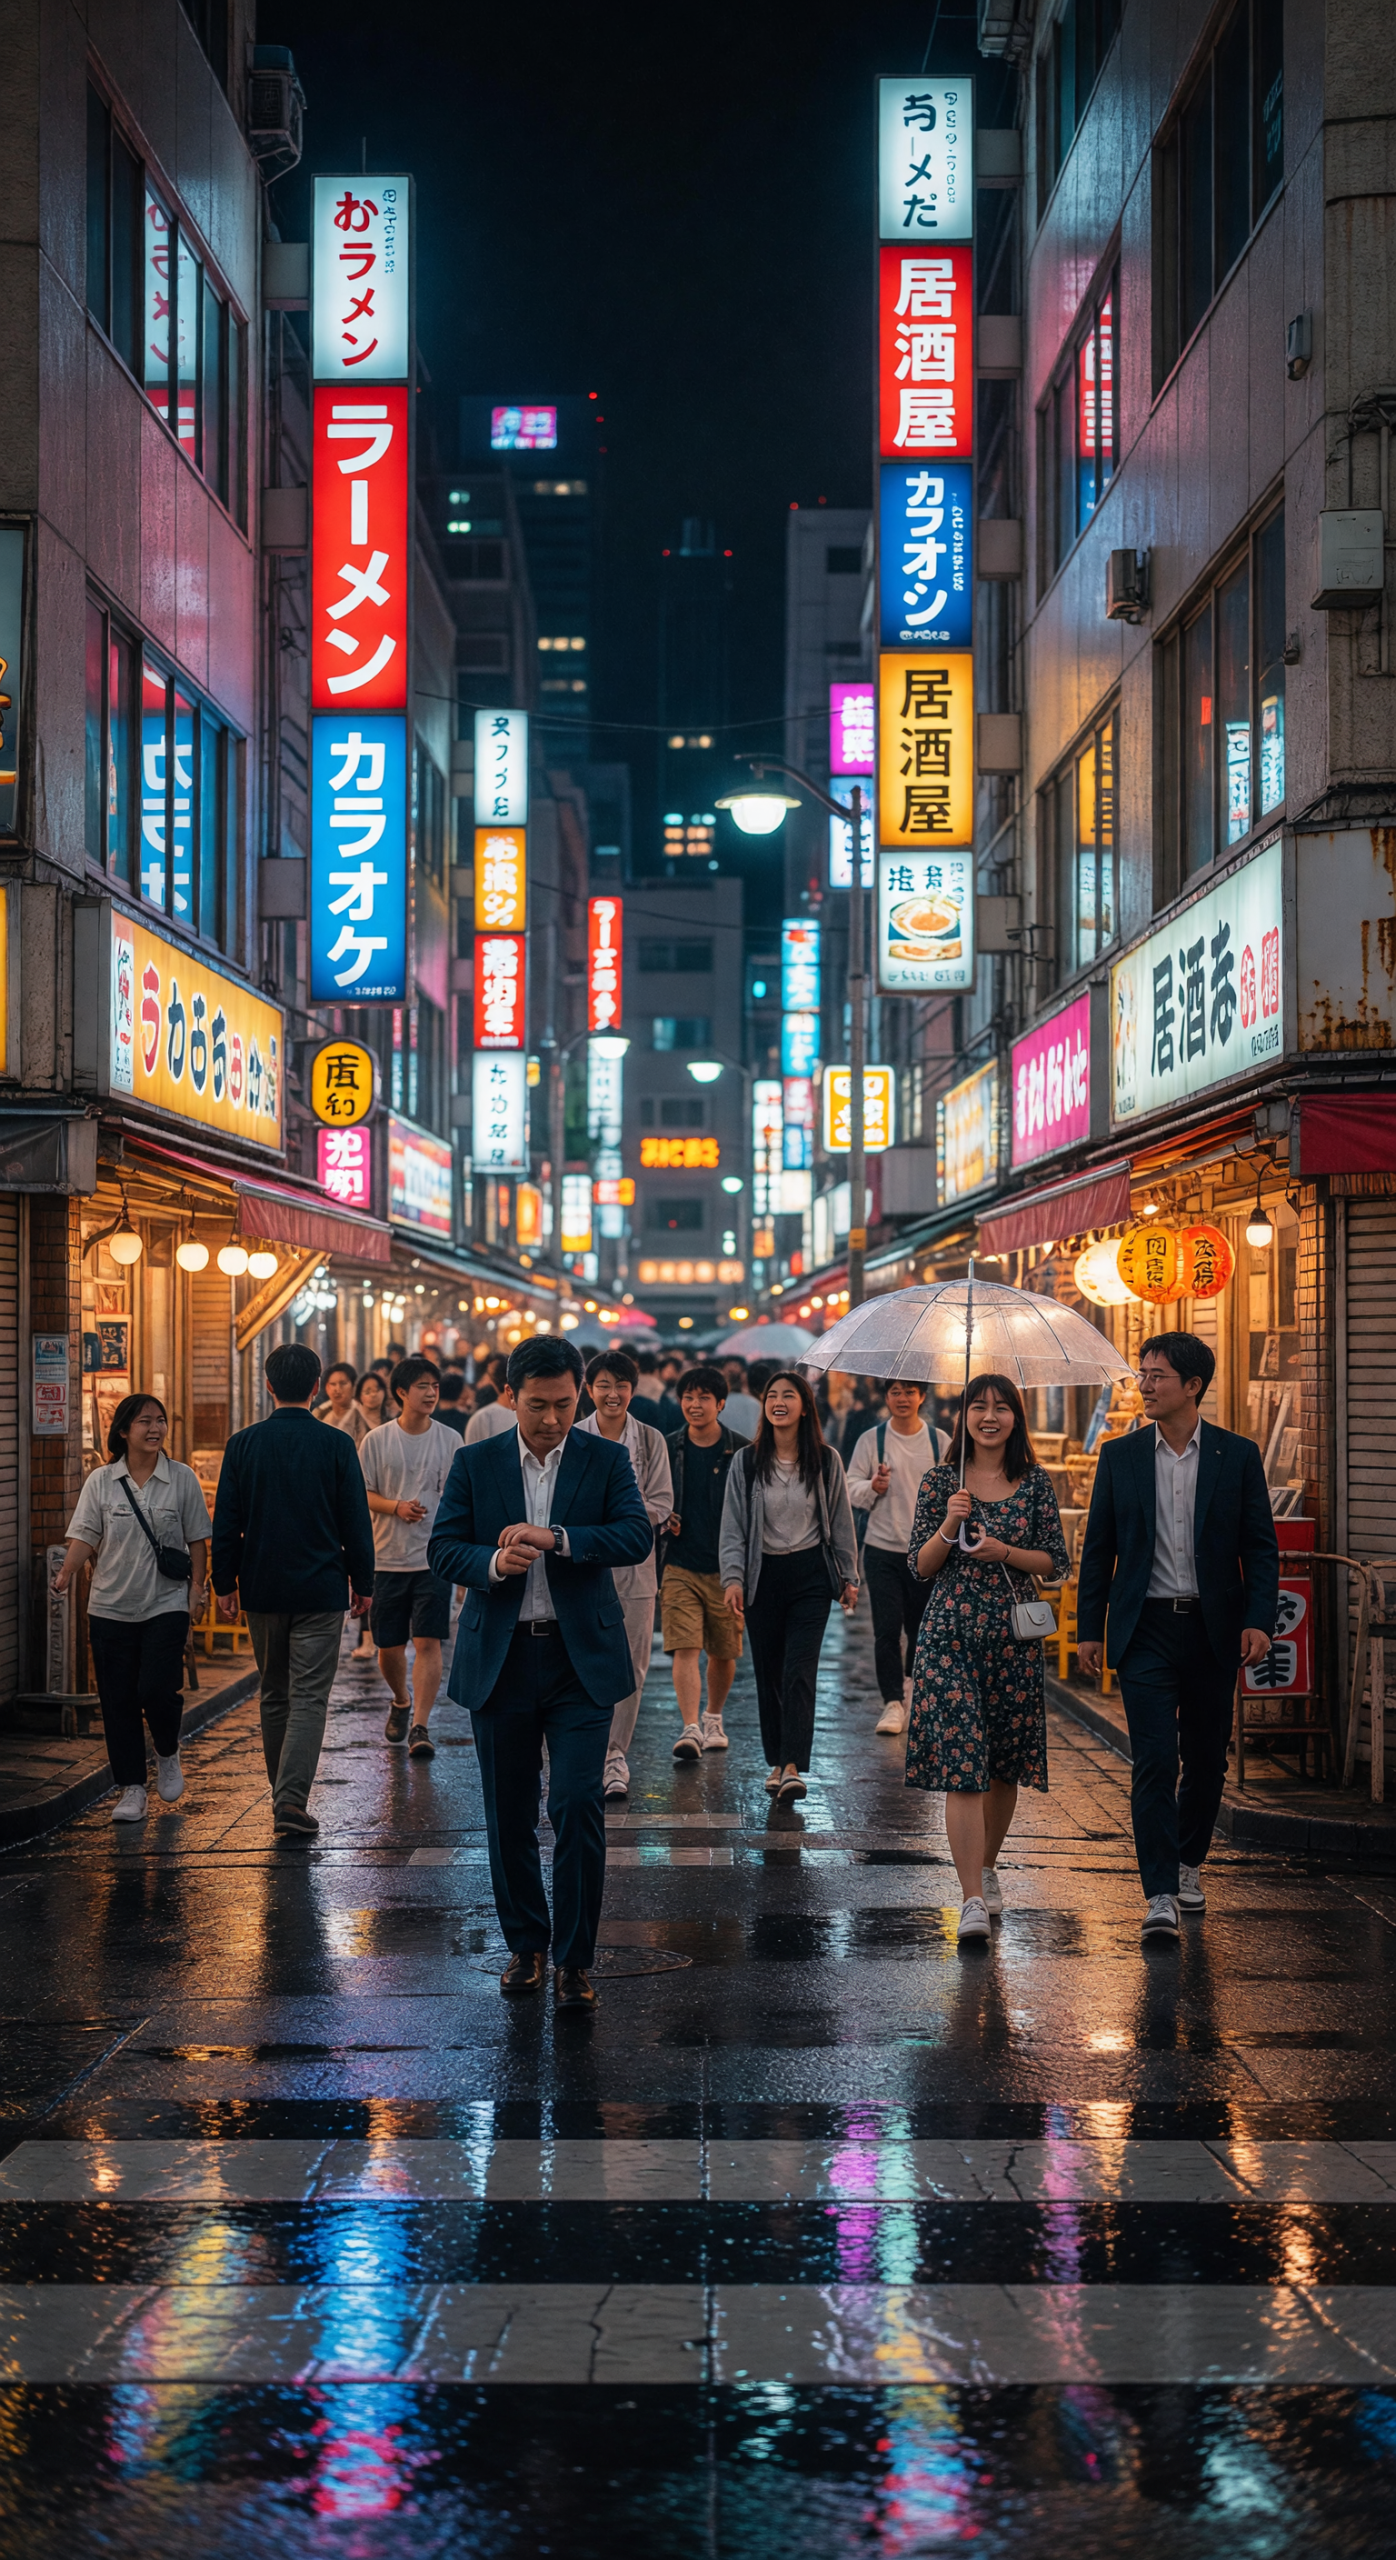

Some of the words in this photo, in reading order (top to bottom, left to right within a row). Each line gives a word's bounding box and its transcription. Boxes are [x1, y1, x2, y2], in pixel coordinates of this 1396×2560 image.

[334, 191, 378, 367] おラメン
[893, 258, 957, 448] 居酒屋
[325, 405, 397, 695] ラーメン
[899, 669, 953, 833] 居酒屋
[328, 732, 388, 988] カラオケ
